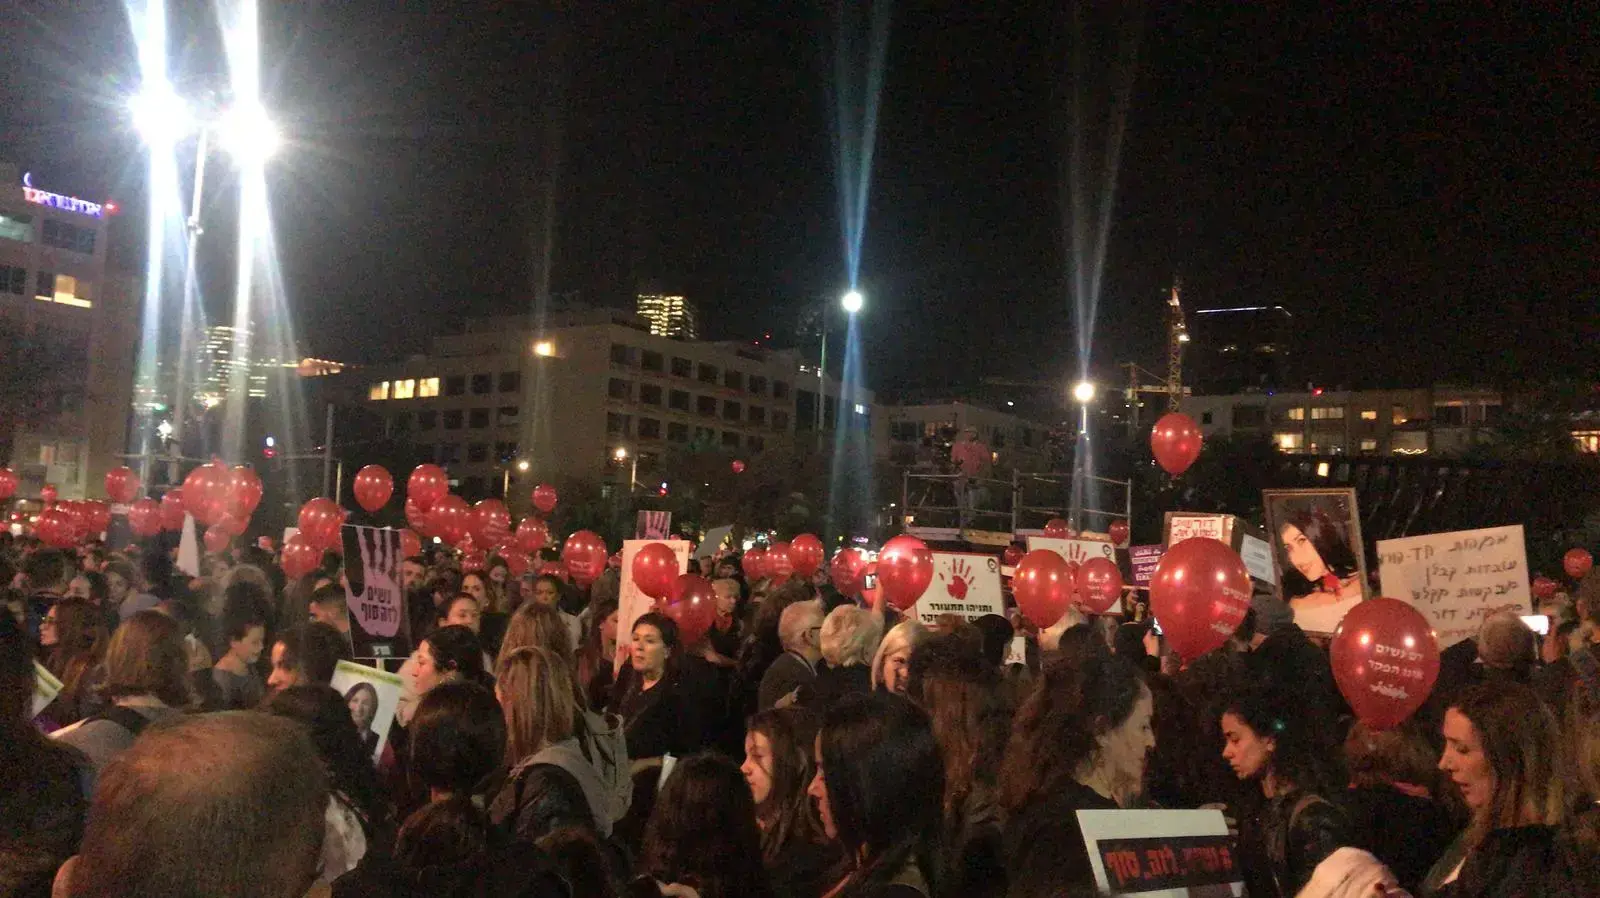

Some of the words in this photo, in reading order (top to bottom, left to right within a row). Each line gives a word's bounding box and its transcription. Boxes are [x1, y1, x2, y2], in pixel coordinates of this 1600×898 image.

[1426, 563, 1457, 585] קבלן
[1464, 560, 1517, 575] עובדות
[367, 585, 392, 605] נשים
[1456, 581, 1519, 603] מבקשות
[361, 603, 379, 622] סוף
[1375, 643, 1406, 659] נשים
[1368, 659, 1401, 675] הפקר
